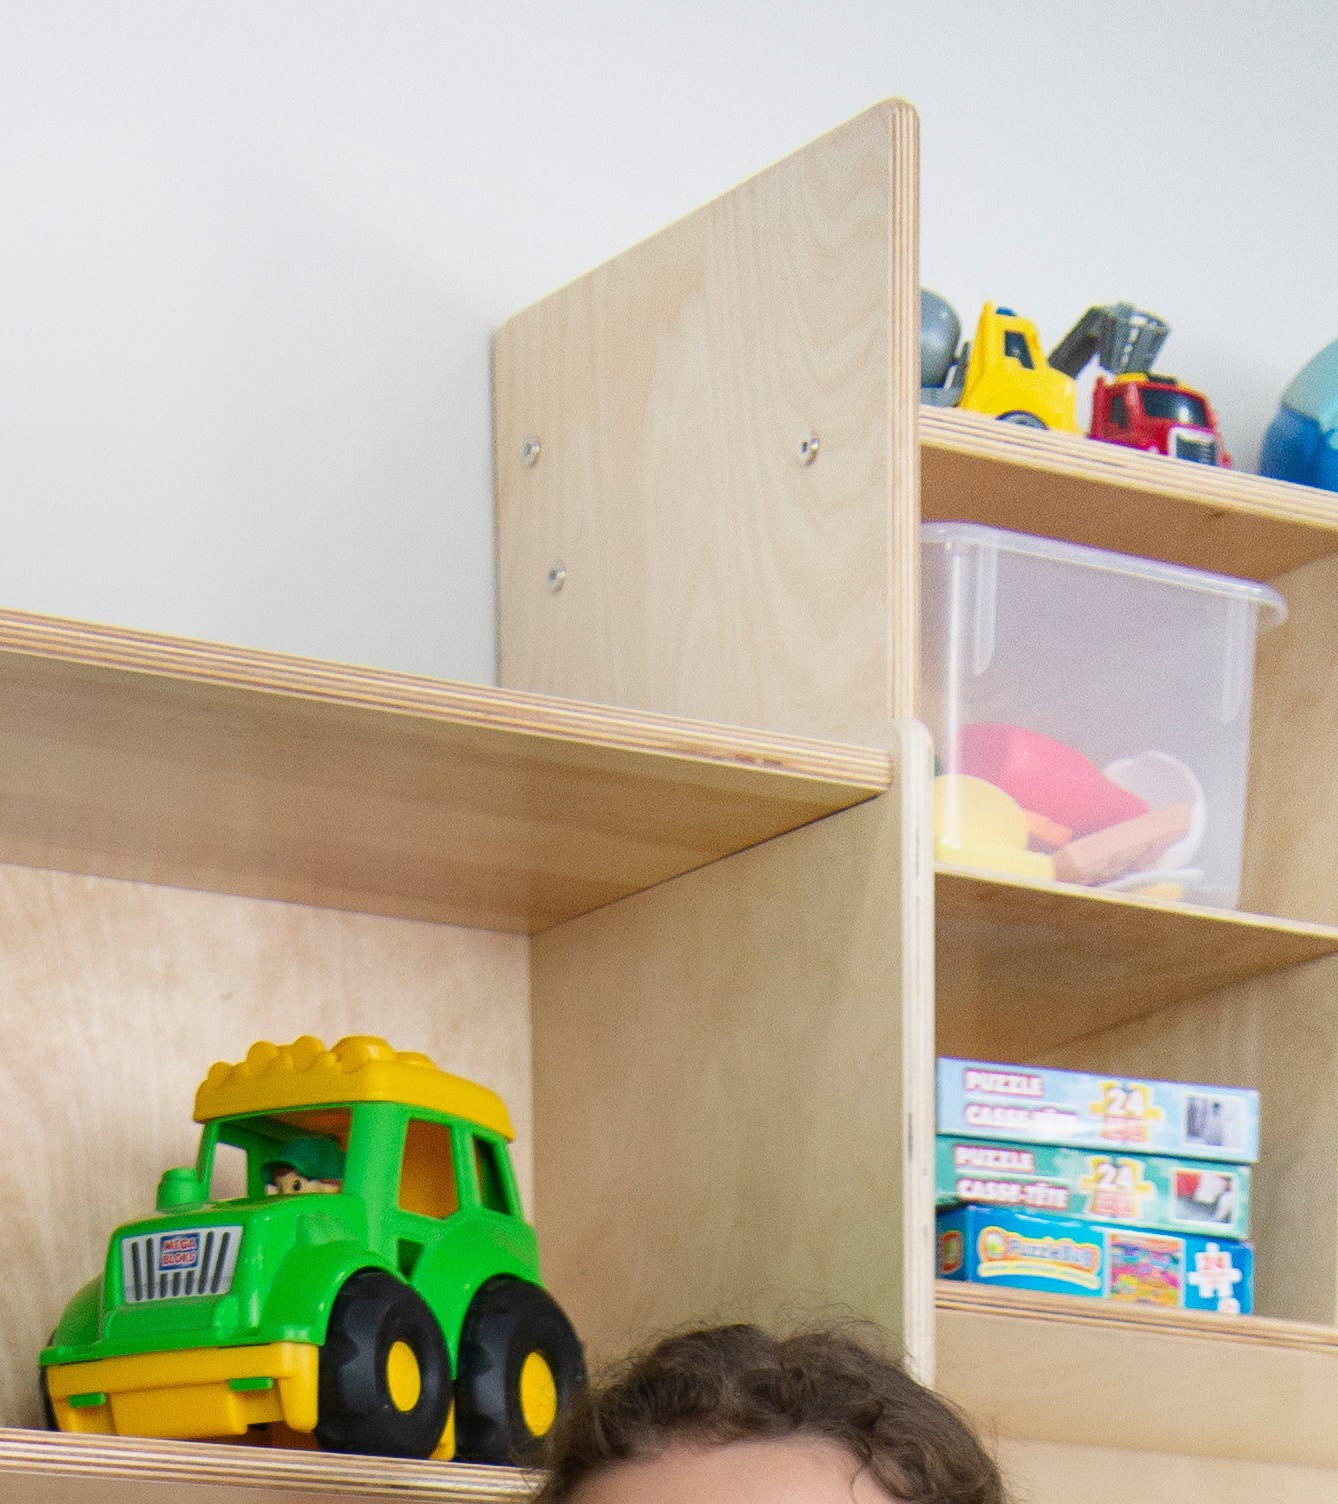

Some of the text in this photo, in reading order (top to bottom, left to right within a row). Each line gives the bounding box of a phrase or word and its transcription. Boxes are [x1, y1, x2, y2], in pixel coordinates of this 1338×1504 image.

[965, 1068, 1043, 1097] PUZZLE
[1105, 1087, 1145, 1117] 24
[954, 1144, 1035, 1172] PUZZLE
[1097, 1162, 1136, 1191] 24
[162, 1251, 195, 1266] BLOKS
[164, 1238, 196, 1251] MEGA
